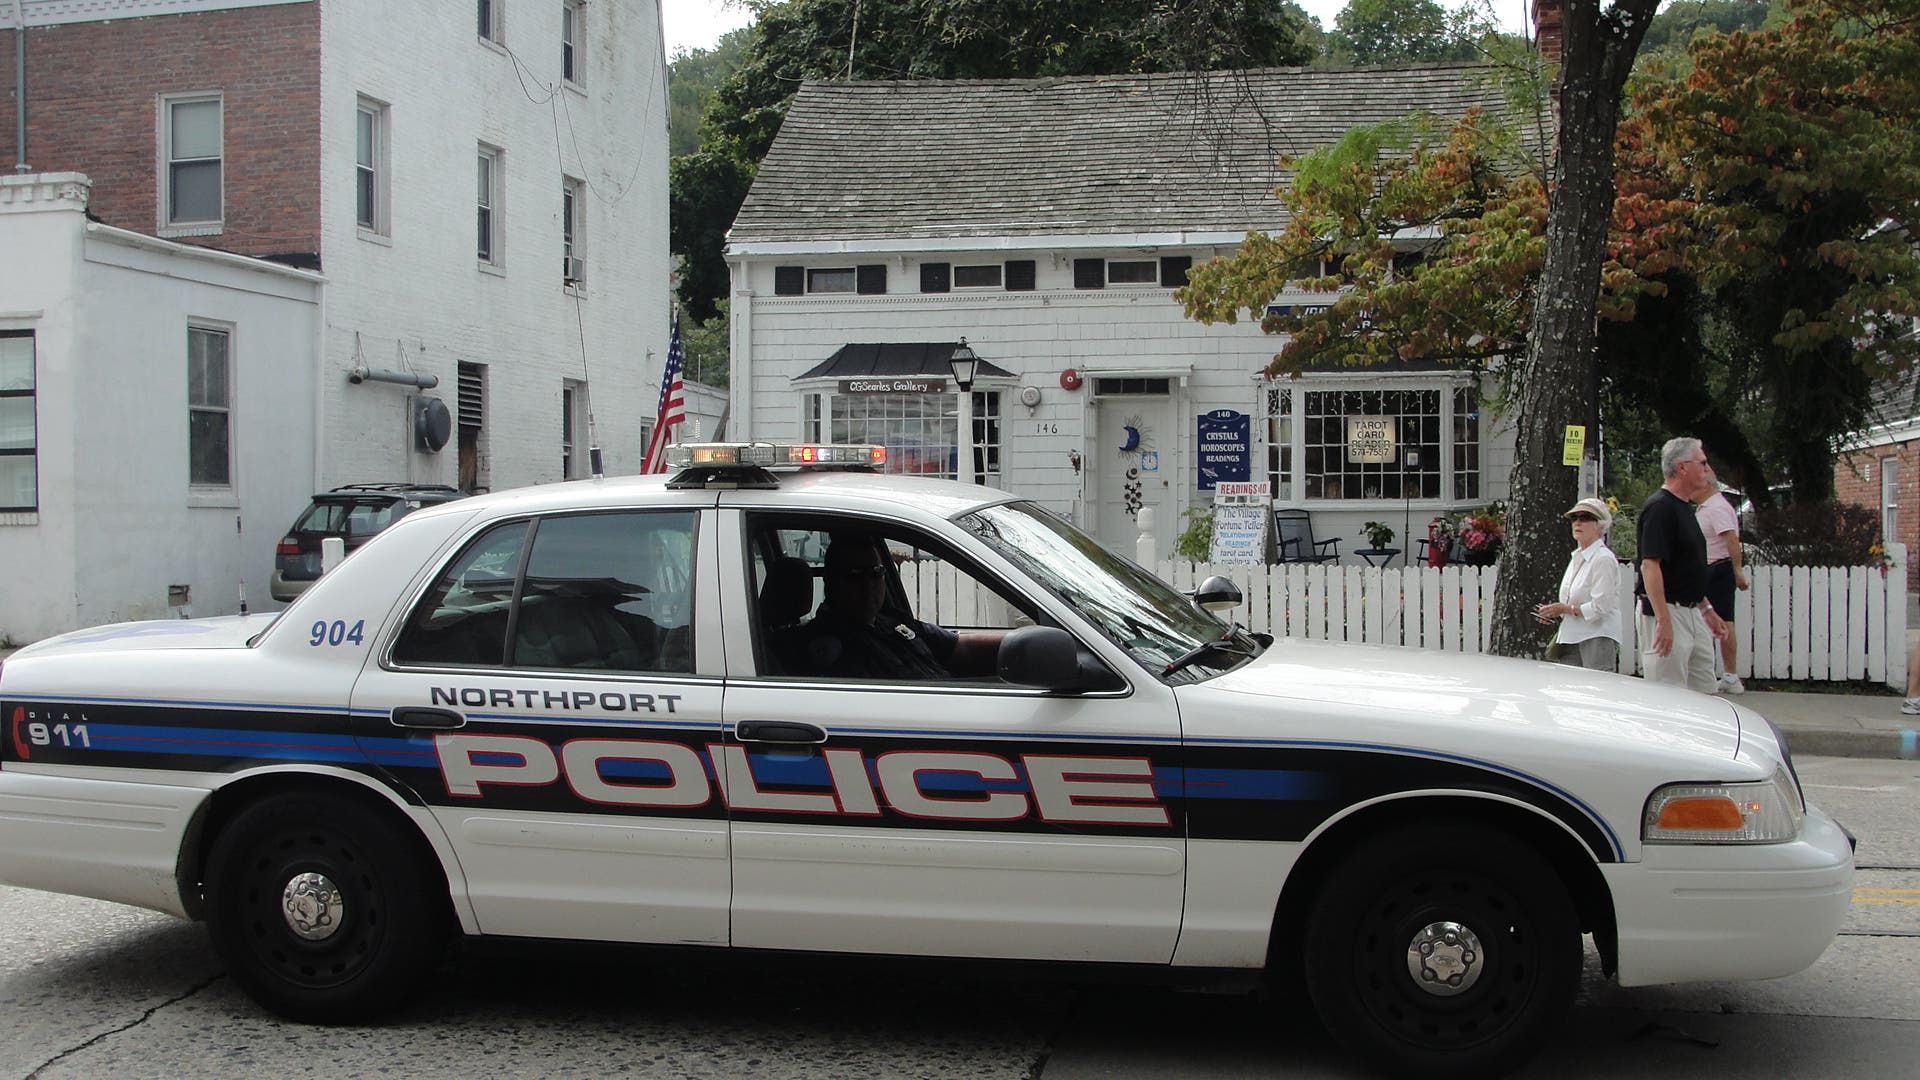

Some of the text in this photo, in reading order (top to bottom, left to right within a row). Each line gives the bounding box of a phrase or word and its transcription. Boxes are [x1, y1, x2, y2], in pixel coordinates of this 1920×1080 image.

[893, 380, 928, 393] Gallery
[1037, 423, 1058, 434] 146
[1355, 421, 1388, 430] TAROT
[1206, 432, 1239, 441] CRYSTALS
[1357, 431, 1385, 439] CARD
[1200, 444, 1245, 452] HOROSCOPES
[1352, 440, 1391, 448] READER
[1206, 455, 1240, 463] READINGS
[1224, 507, 1261, 520] The Village
[1216, 520, 1263, 530] Fortune Teller
[310, 619, 365, 646] 904
[430, 687, 682, 713] NORTHPORT
[29, 711, 88, 720] DIAL
[29, 722, 90, 747] 911
[432, 732, 1172, 827] POLICE
